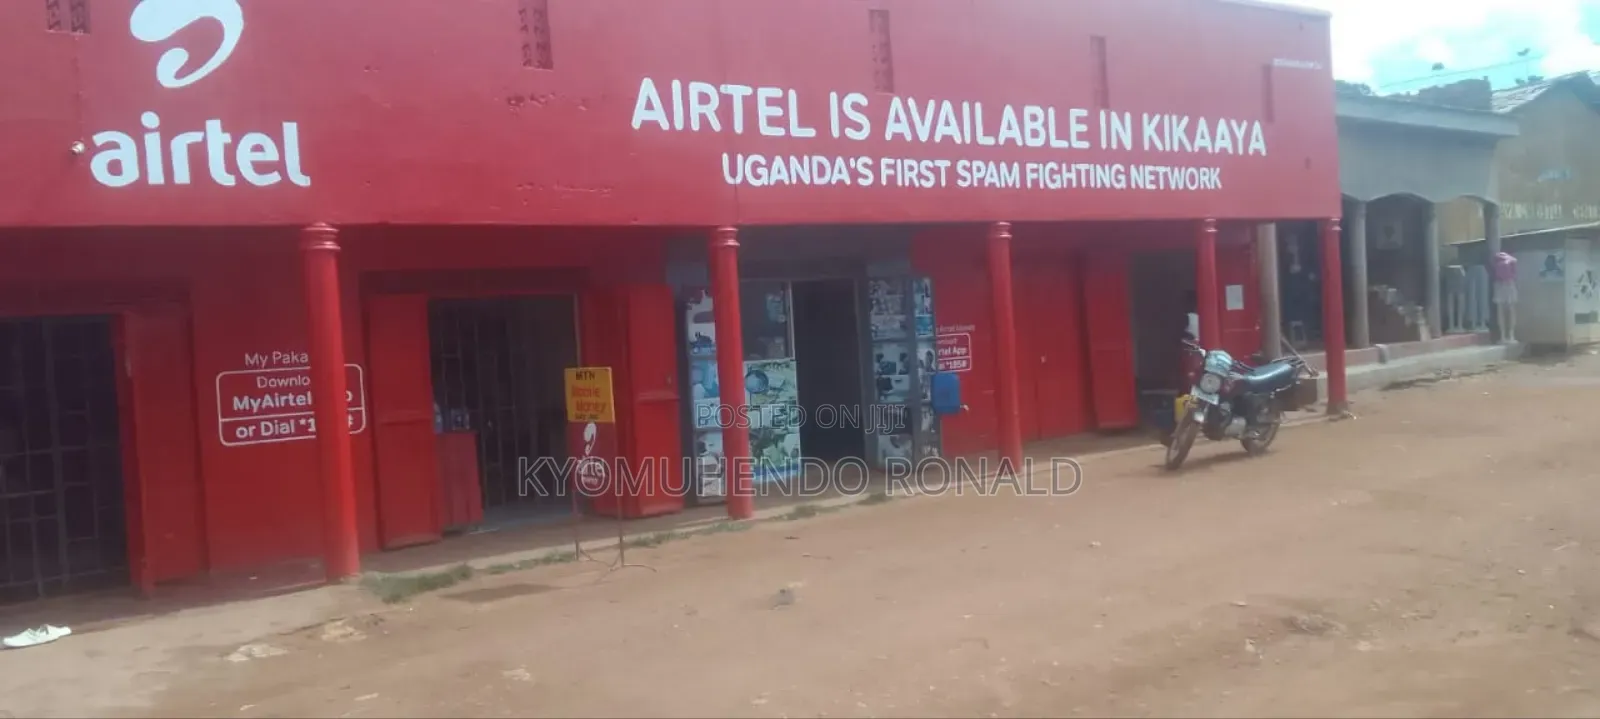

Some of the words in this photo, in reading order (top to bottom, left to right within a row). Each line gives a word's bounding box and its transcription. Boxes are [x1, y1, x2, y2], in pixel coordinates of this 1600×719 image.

[631, 76, 816, 138] AIRTEL
[829, 90, 871, 140] IS
[884, 96, 1090, 150] AVAILABLE
[1099, 109, 1132, 151] IN
[1142, 112, 1267, 157] KIKAAYA
[89, 110, 311, 188] airtel
[721, 152, 875, 188] UGANDA'S
[880, 156, 952, 188] FIRST
[955, 158, 1021, 189] SPAM
[1025, 161, 1127, 190] FIGHTING
[1129, 163, 1223, 191] NETWORK
[244, 352, 268, 368] My
[256, 374, 312, 389] Downlo
[232, 390, 312, 413] MyAirtel
[235, 425, 257, 438] or
[260, 420, 296, 436] Dial
